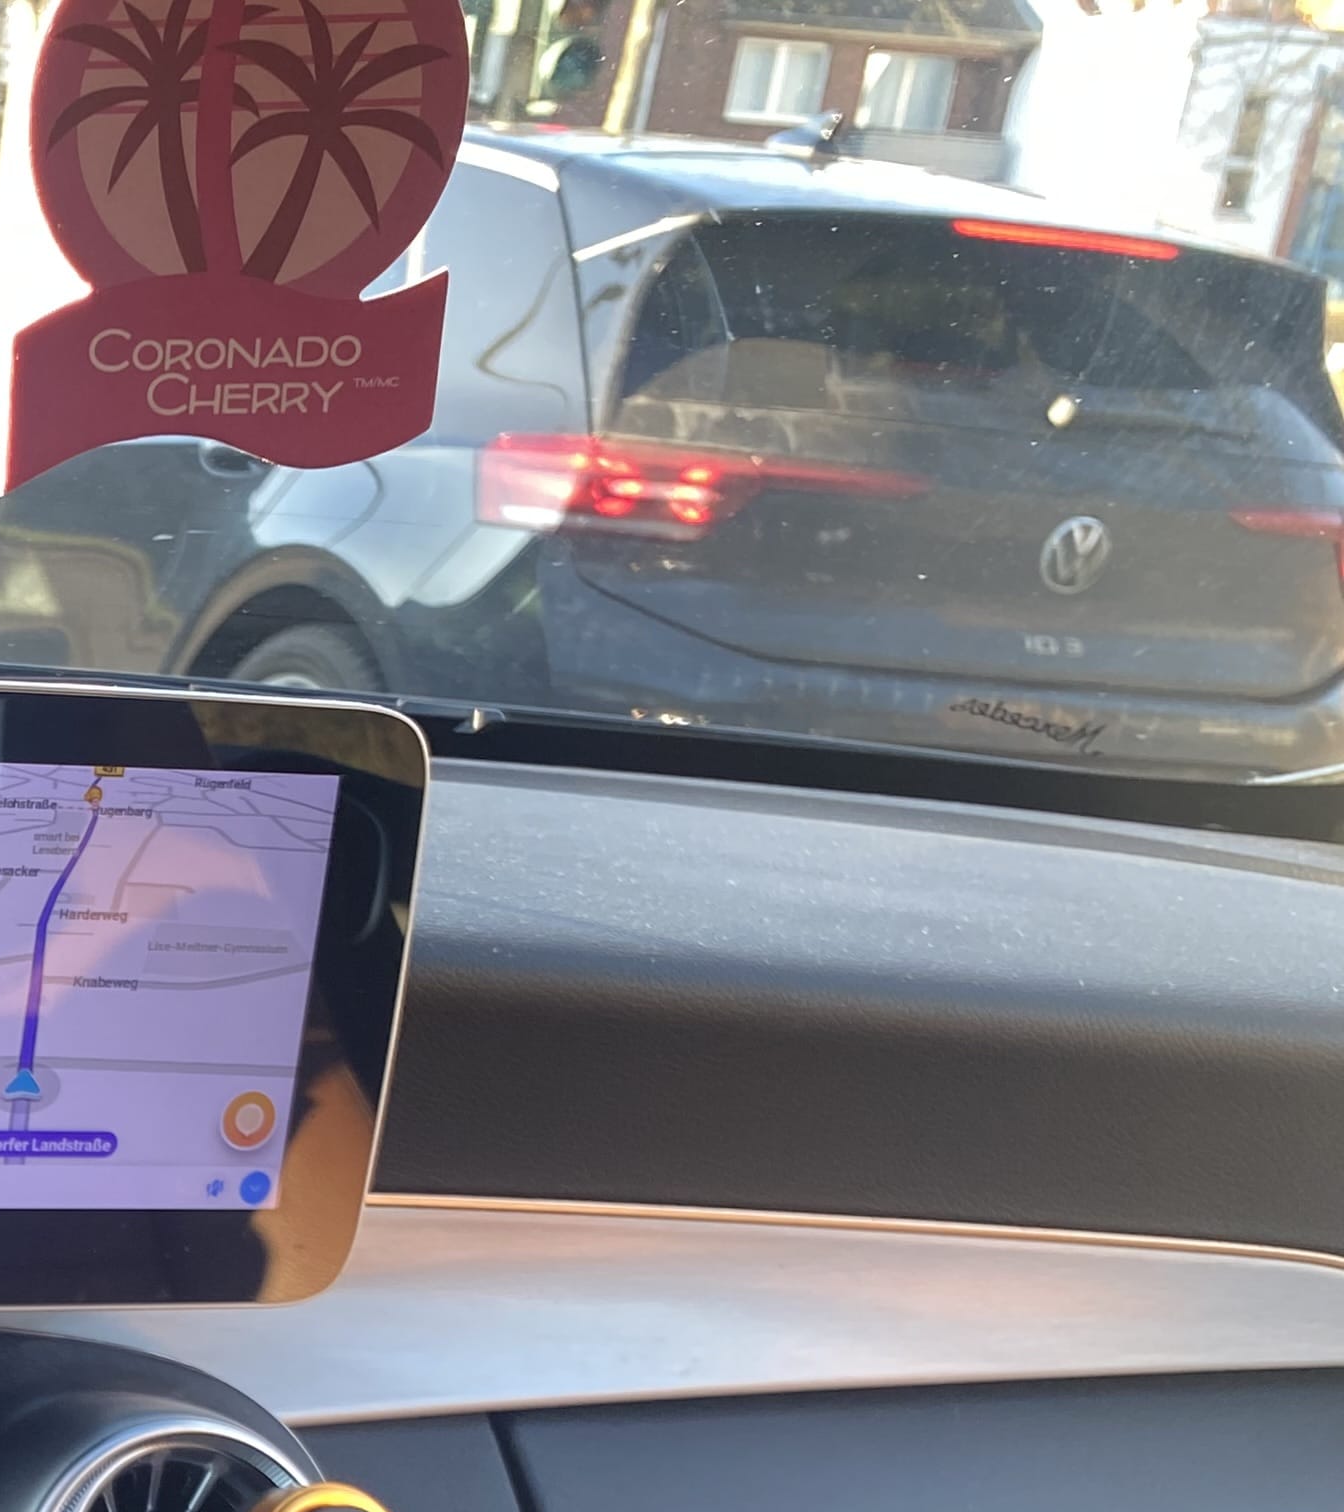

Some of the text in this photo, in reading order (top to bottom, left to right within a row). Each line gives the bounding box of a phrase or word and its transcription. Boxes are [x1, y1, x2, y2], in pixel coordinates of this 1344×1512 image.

[59, 908, 128, 923] Harderweg
[73, 976, 138, 990] Knabeweg
[32, 1138, 111, 1153] Landstraße
